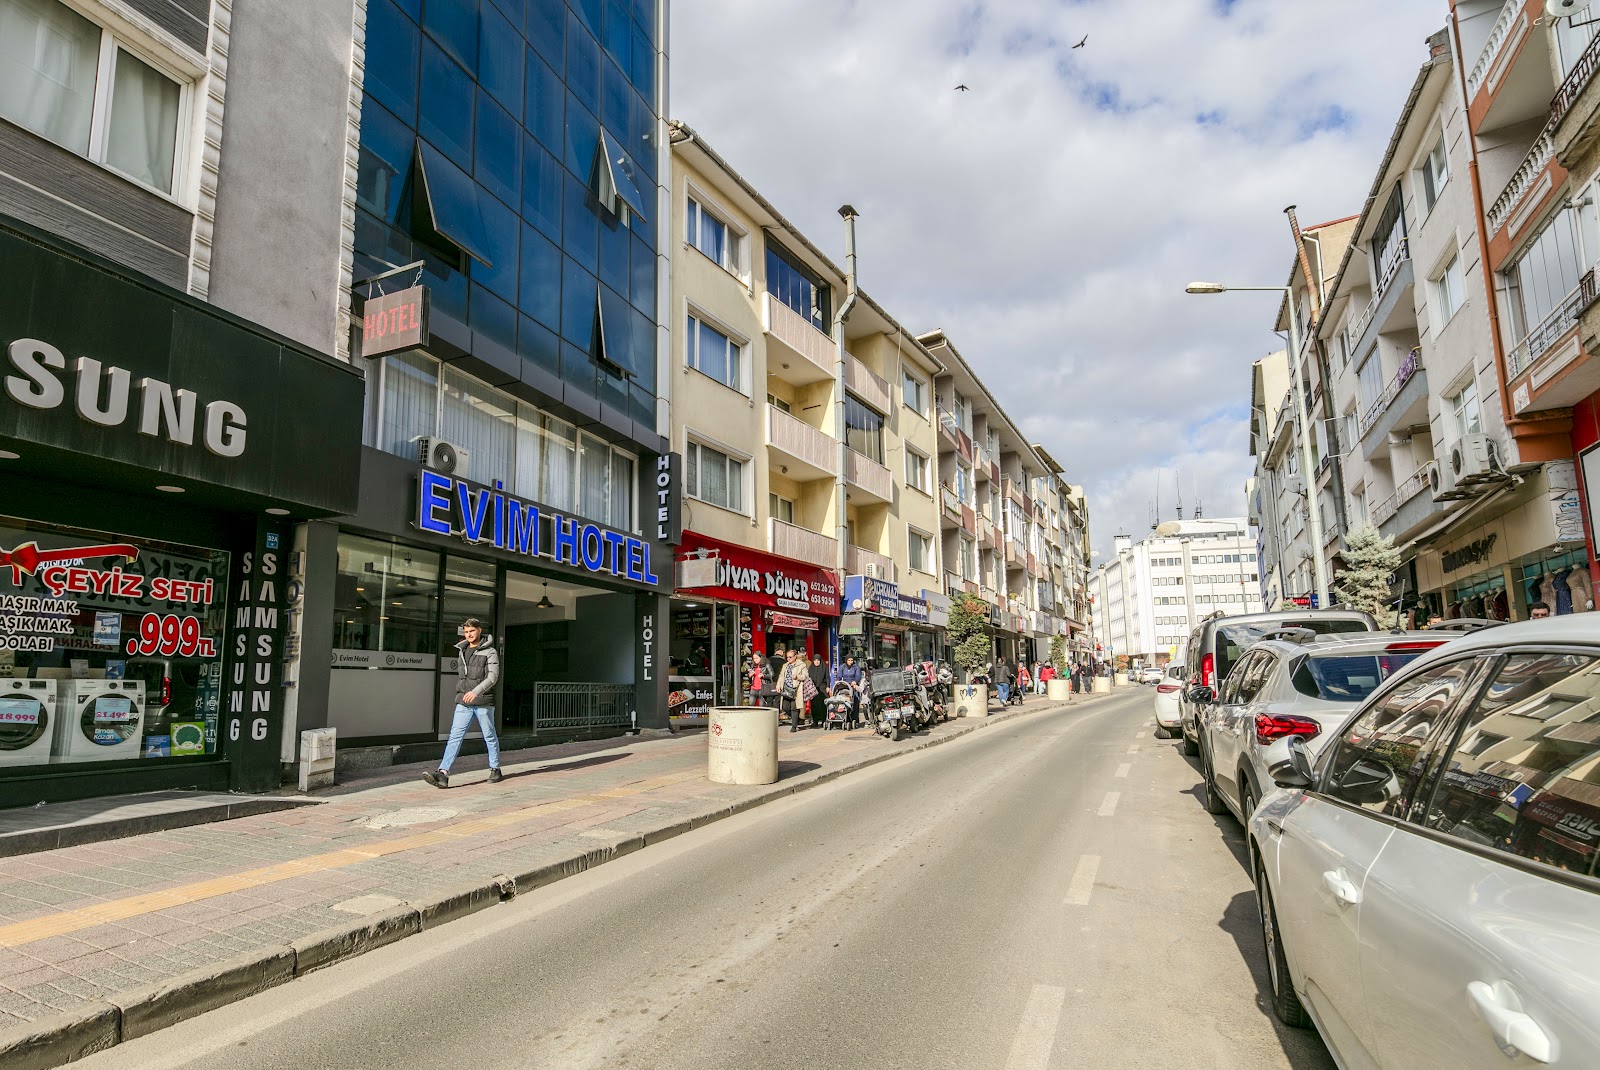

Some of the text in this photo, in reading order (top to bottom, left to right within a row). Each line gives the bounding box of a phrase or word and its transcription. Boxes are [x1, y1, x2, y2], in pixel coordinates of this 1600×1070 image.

[364, 303, 419, 342] HOTEL
[4, 338, 248, 458] SUNG
[657, 454, 670, 540] HOTEL
[268, 534, 278, 542] 32A
[418, 468, 659, 586] EVİM HOTEL
[42, 566, 144, 598] ÇEYİZ
[150, 577, 213, 604] SETİ
[764, 571, 809, 601] DÖNER
[810, 581, 834, 594] 652 26 23
[810, 594, 821, 603] 653
[41, 599, 80, 615] MAK.
[898, 600, 911, 612] TANER
[35, 617, 74, 633] MAK.
[229, 551, 253, 741] SAMSUNG
[251, 552, 278, 741] SAMSUNG
[642, 615, 653, 682] HOTEL
[684, 703, 710, 714] Lezzetle
